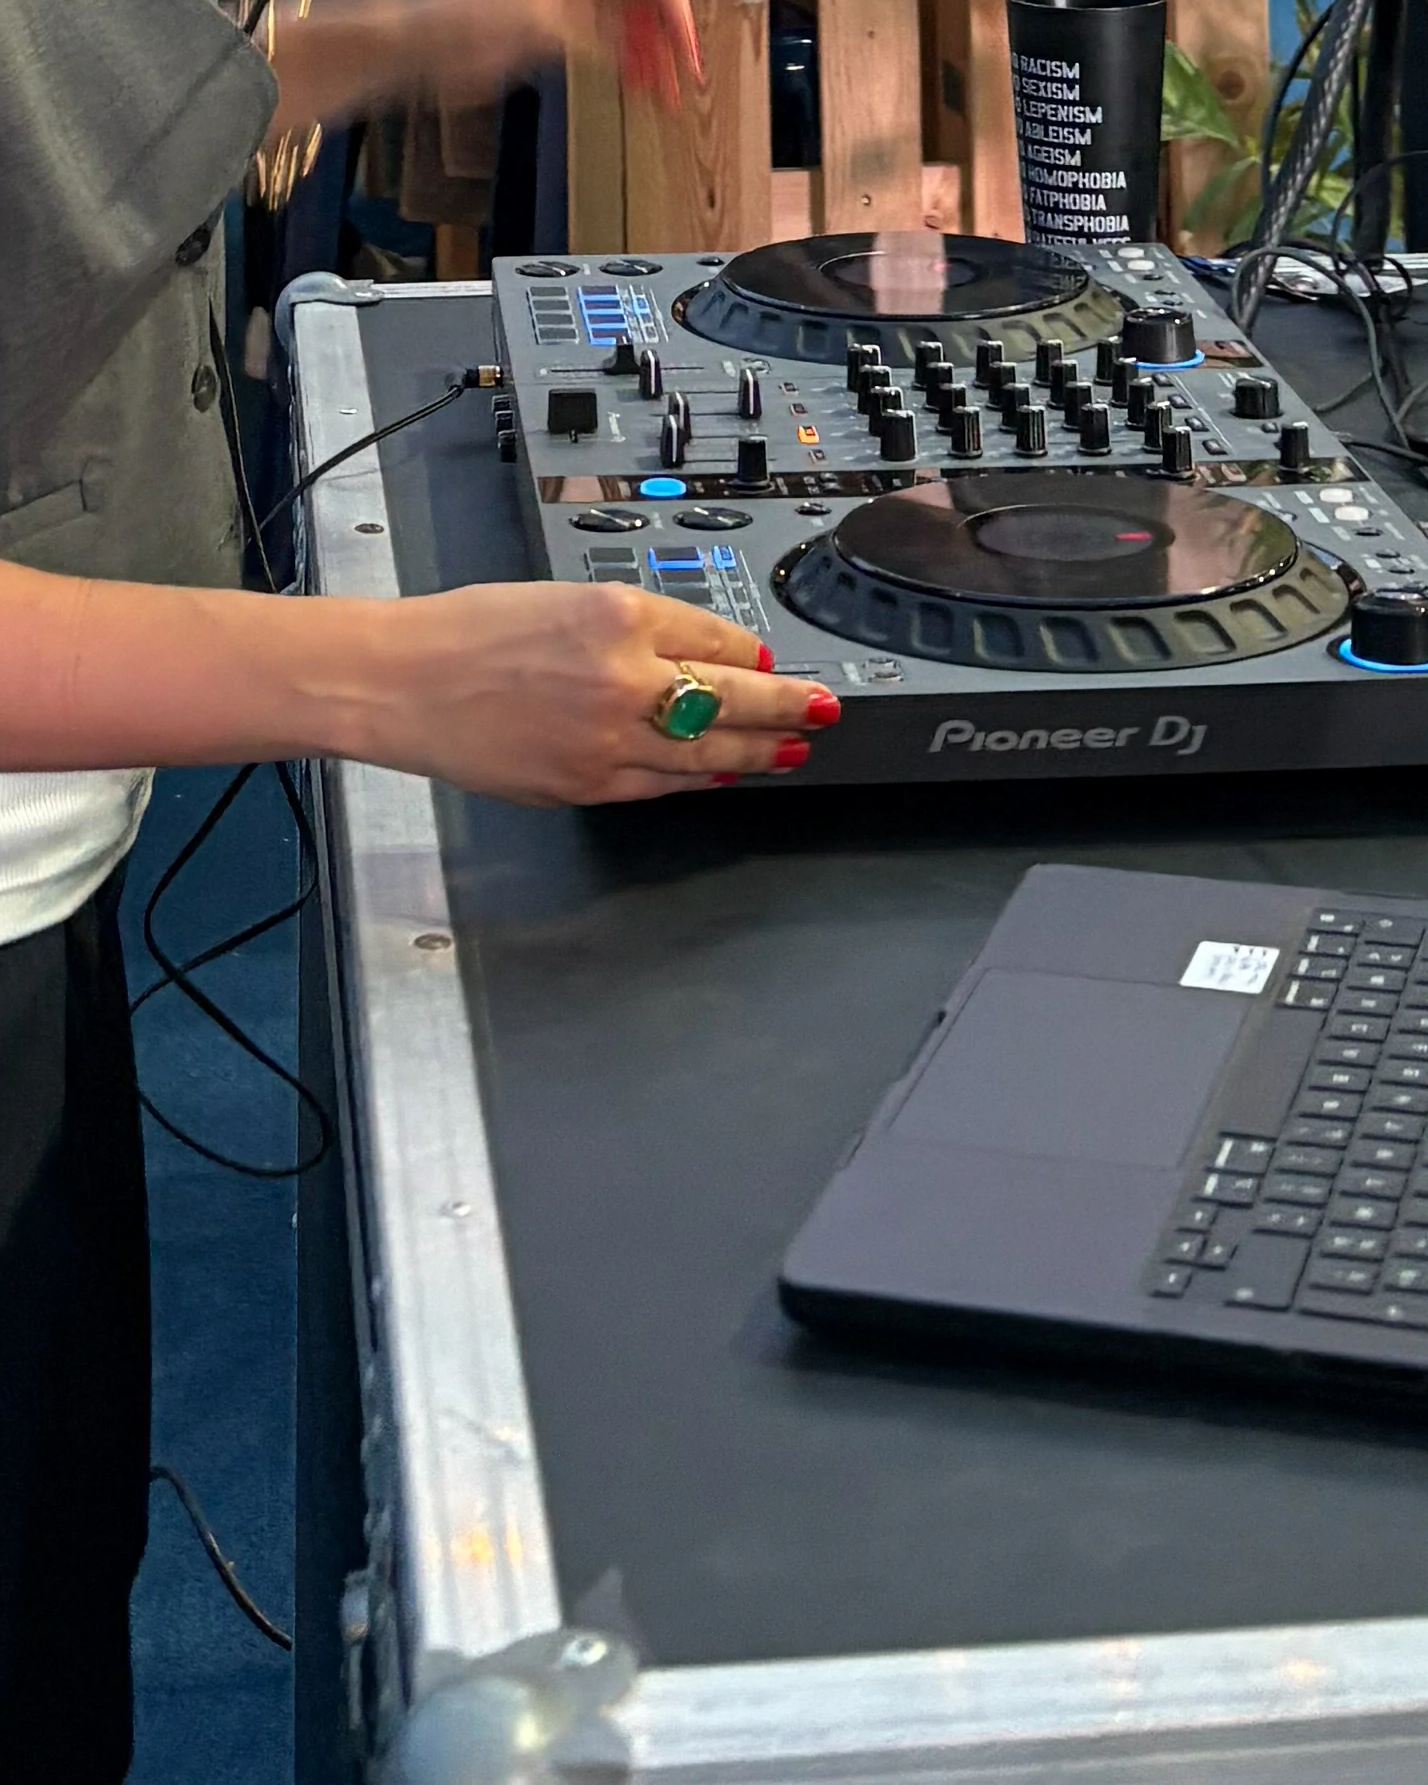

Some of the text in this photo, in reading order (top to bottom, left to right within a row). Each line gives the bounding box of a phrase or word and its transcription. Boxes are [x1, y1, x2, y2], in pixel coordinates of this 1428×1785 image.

[1020, 55, 1080, 79] RACISM
[1022, 77, 1080, 101] SEXISM
[1023, 98, 1103, 123] LEPENISM
[1025, 121, 1092, 145] ABLEISM
[1028, 165, 1127, 189] HOMOPHOBIA
[1030, 187, 1107, 211] FATPHOBIA
[1032, 208, 1130, 233] TRANSPHOBIA
[928, 719, 1141, 753] Pioneer
